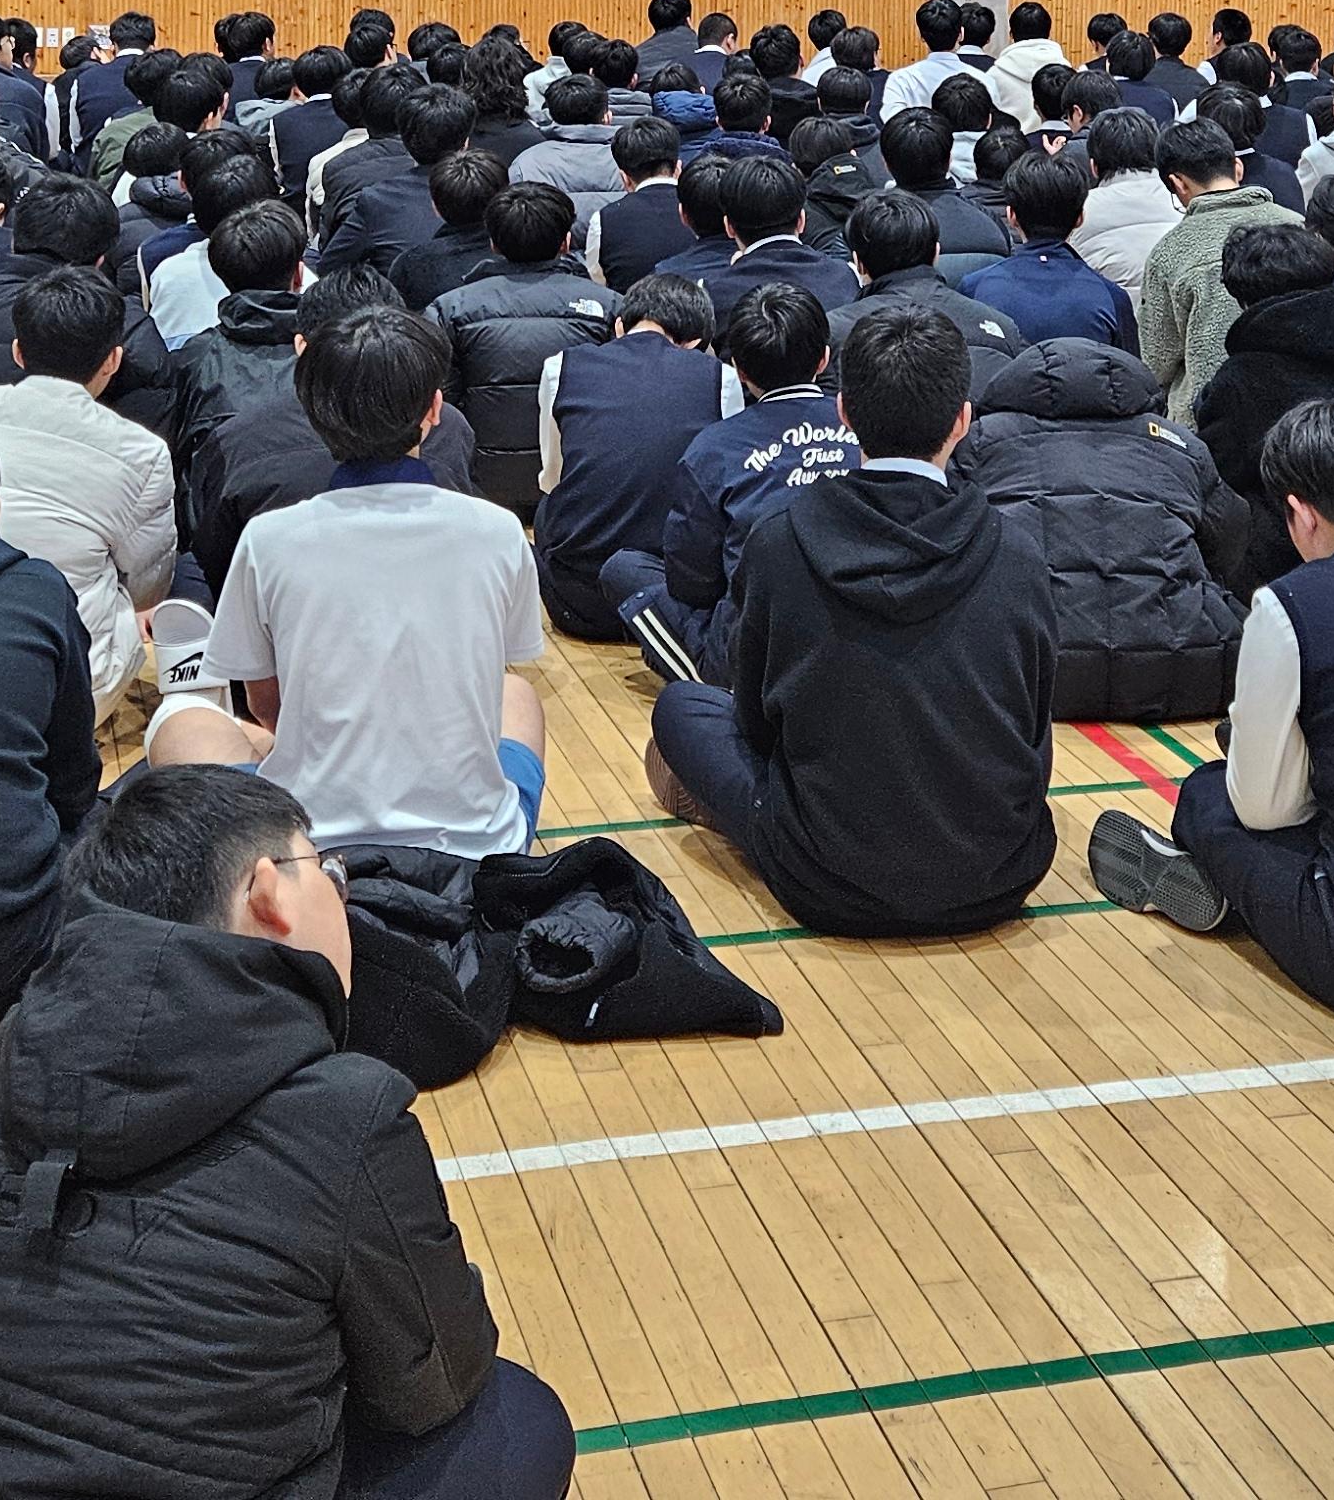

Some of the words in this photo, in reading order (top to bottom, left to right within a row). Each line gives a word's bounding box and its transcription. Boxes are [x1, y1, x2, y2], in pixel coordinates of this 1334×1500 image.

[743, 442, 783, 472] The
[801, 447, 845, 468] Just
[168, 664, 201, 684] NIKE
